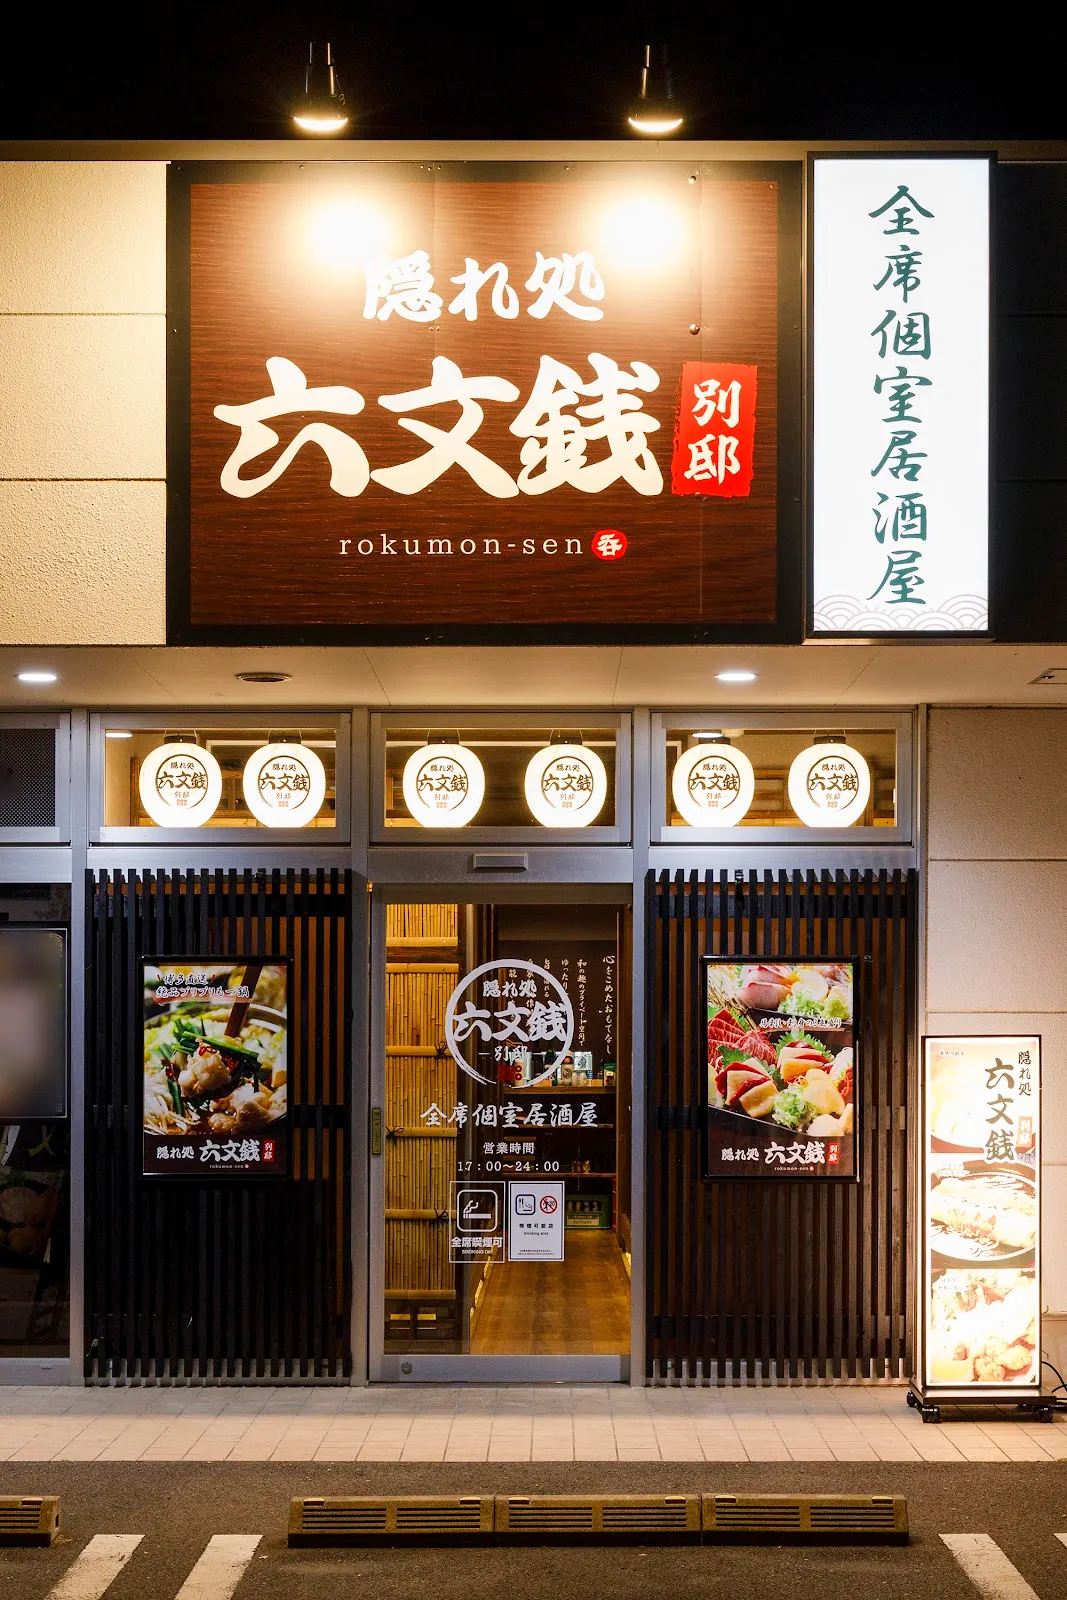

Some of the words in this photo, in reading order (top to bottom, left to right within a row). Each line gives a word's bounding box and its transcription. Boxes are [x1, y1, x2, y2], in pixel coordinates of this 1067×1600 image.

[362, 249, 606, 322] 隠れ処
[868, 184, 935, 606] 全席個室居酒屋
[212, 353, 664, 499] 六文銭
[683, 377, 742, 486] 別邸
[339, 532, 584, 556] rokumon-sen
[158, 771, 206, 790] 六文銭
[258, 772, 308, 792] 六文銭
[417, 773, 468, 792] 六文銭
[544, 773, 592, 792] 六文銭
[690, 772, 738, 791] 六文銭
[808, 772, 857, 792] 六文銭
[483, 979, 537, 998] 隠れ処
[602, 955, 616, 1054] 心をこめたおもてなし
[452, 1000, 568, 1042] 六文銭
[494, 1045, 528, 1062] 別邸
[1018, 1050, 1032, 1096] 隠れ処
[420, 1102, 598, 1128] 全席個室居酒屋
[984, 1058, 1014, 1160] 六文銭
[156, 1146, 194, 1160] 隠れ処
[199, 1138, 260, 1162] 六文銭
[483, 1142, 534, 1154] 営業時間
[722, 1148, 759, 1160] 隠れ処
[764, 1141, 826, 1164] 六文銭
[452, 1236, 503, 1248] 全席喫煙可
